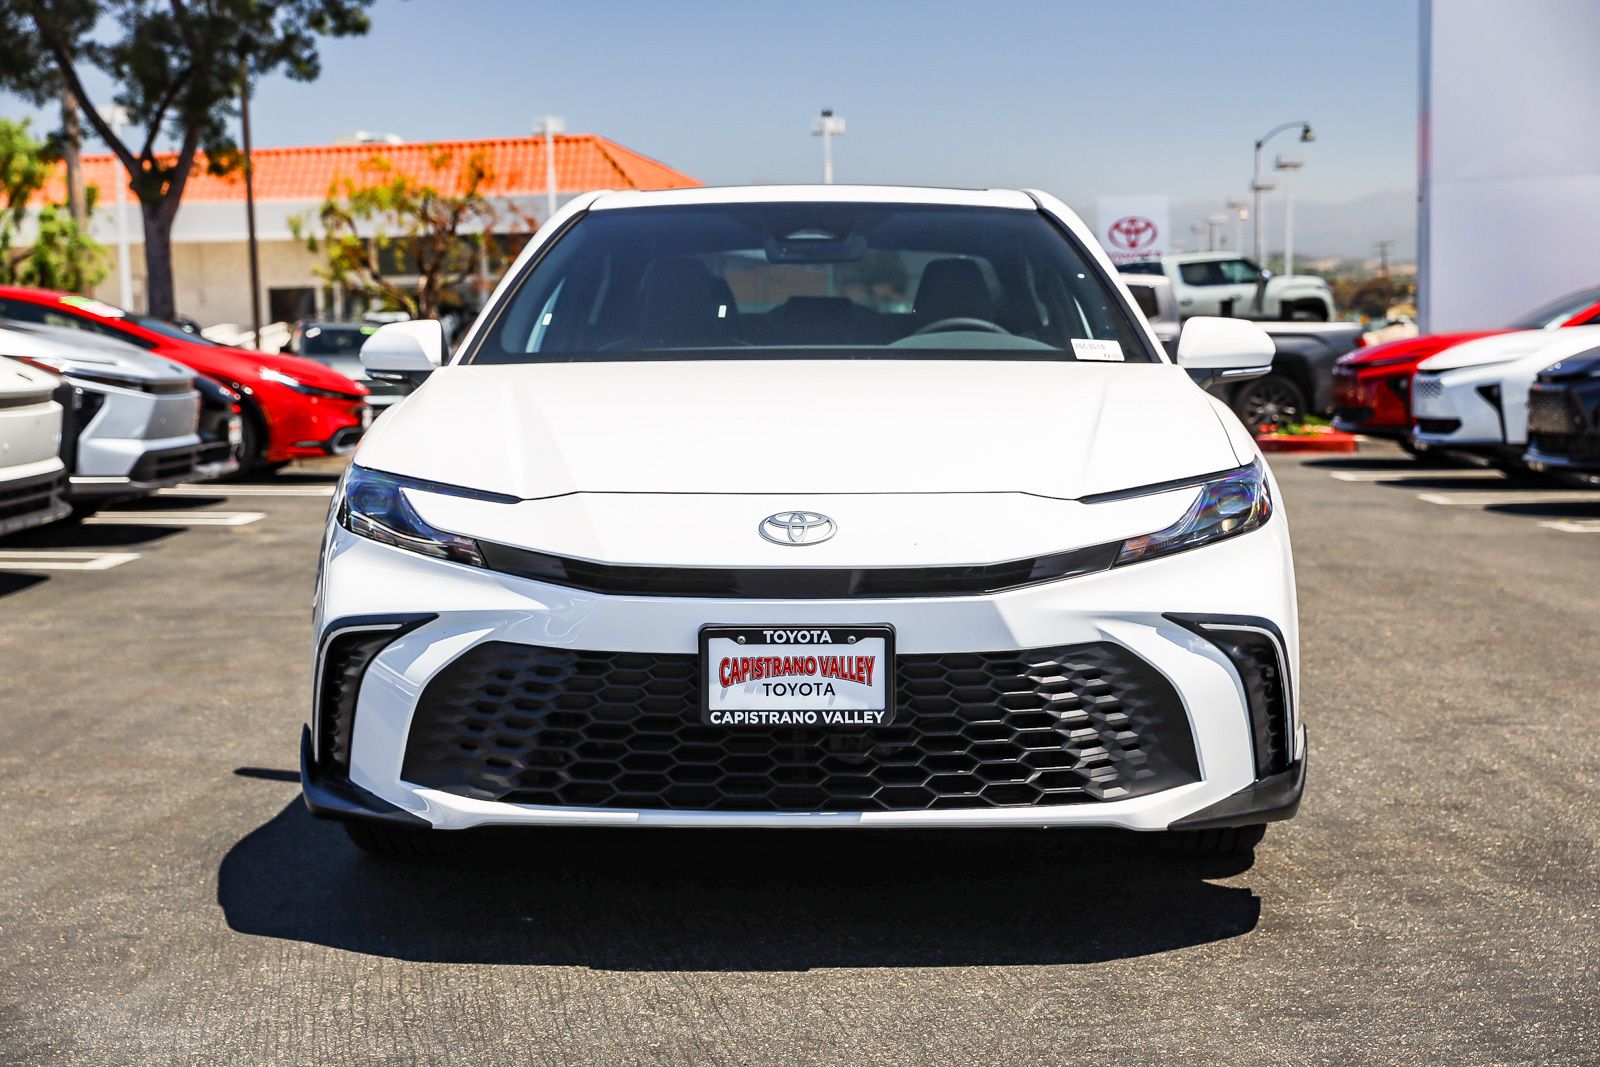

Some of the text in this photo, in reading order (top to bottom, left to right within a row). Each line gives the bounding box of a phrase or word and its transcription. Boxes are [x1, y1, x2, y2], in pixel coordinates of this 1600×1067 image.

[763, 630, 832, 644] TOYOTA
[719, 656, 876, 688] CAPISTRANO VALLEY
[762, 682, 836, 696] TOYOTA
[710, 711, 885, 725] CAPISTRANO VALLEY
